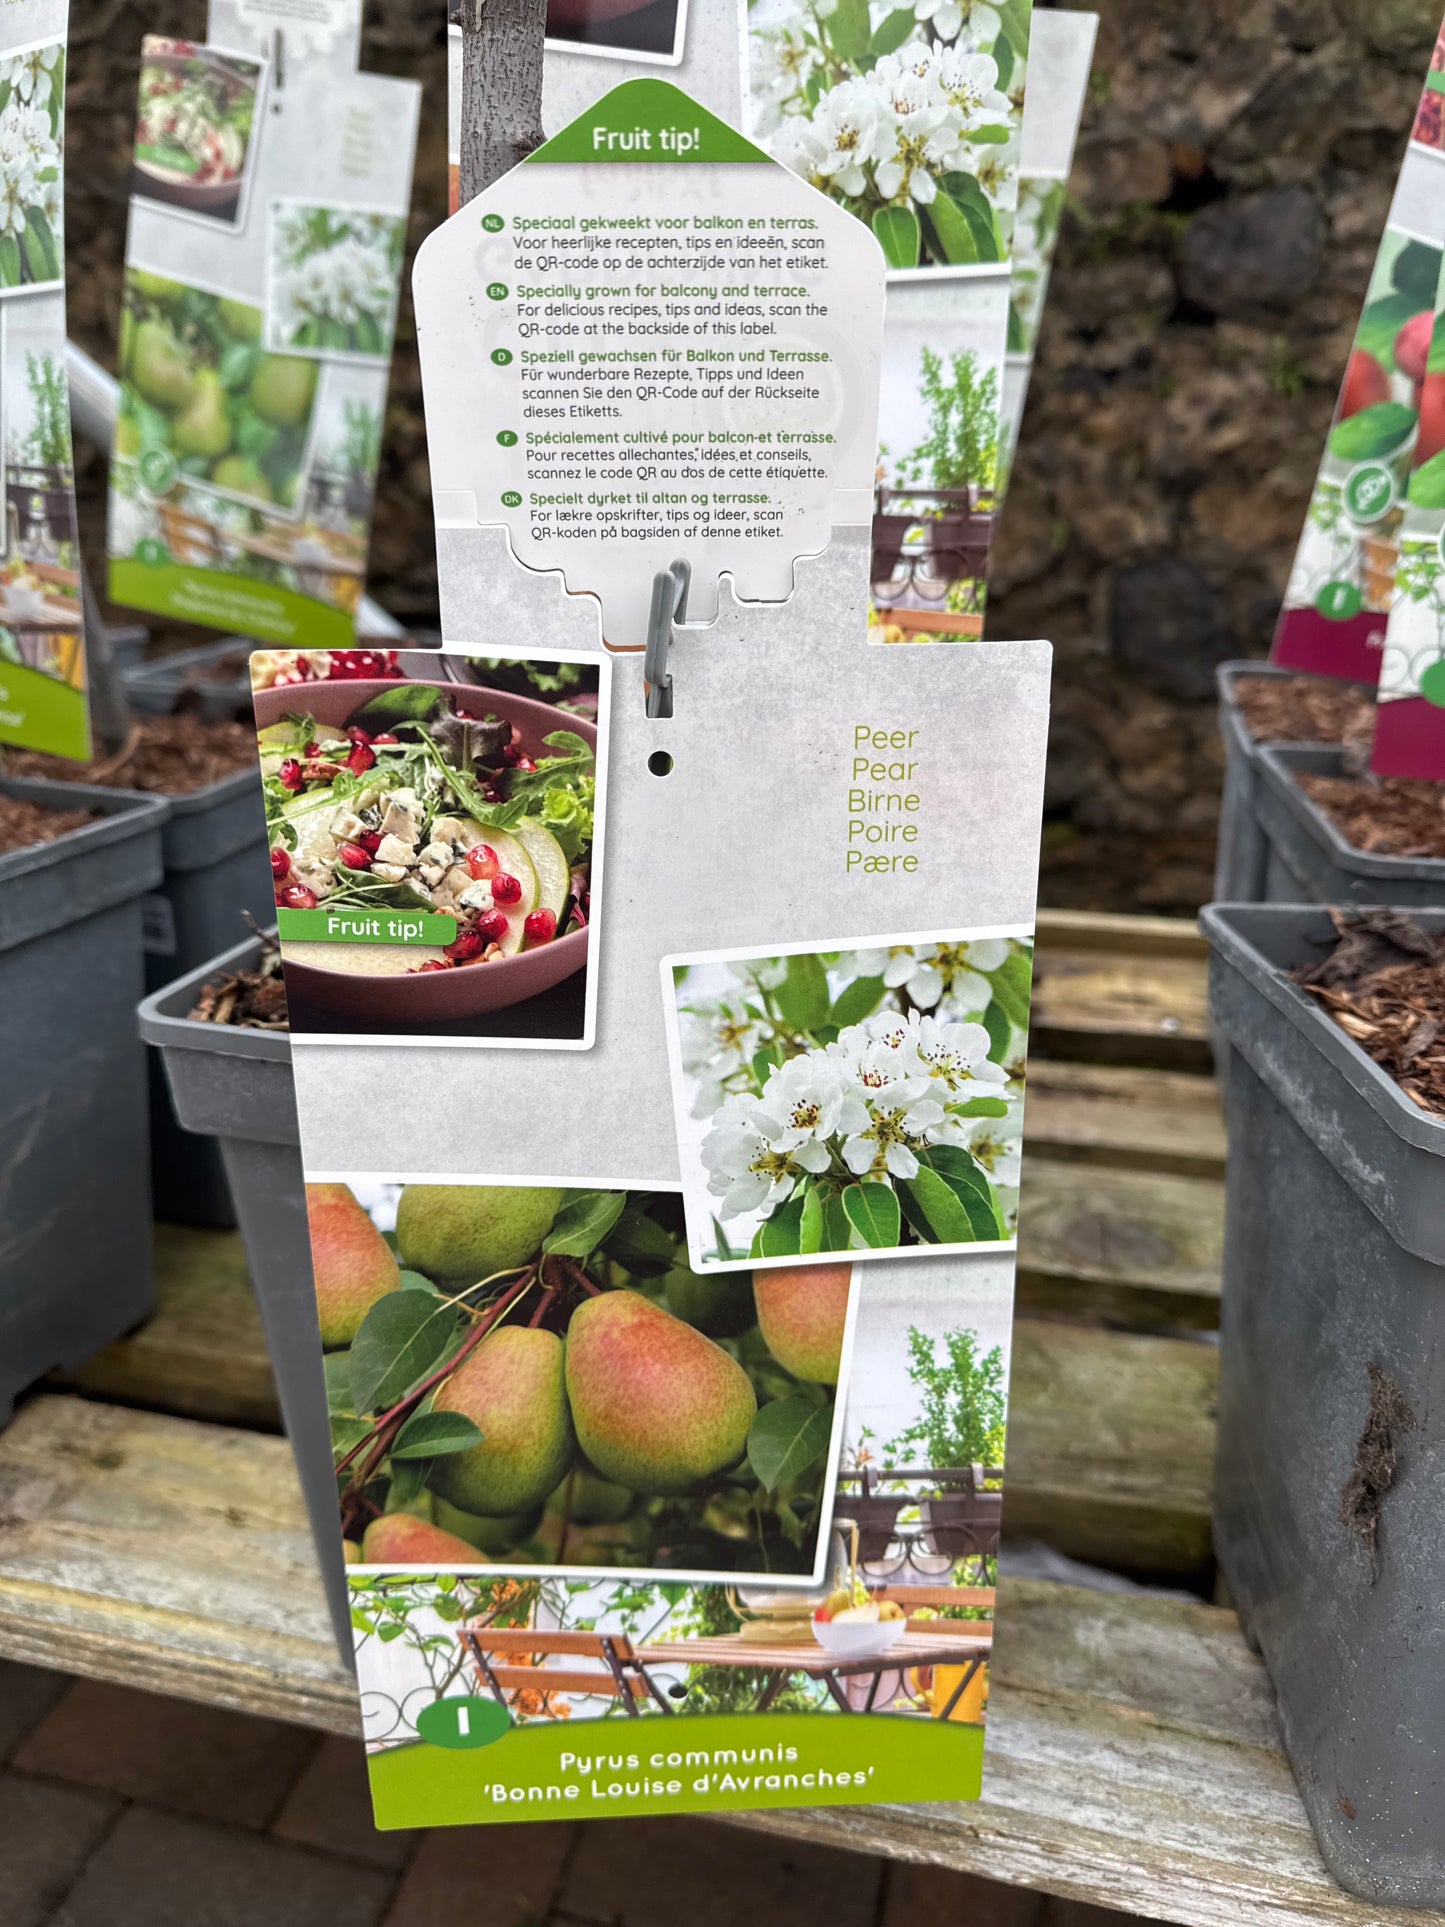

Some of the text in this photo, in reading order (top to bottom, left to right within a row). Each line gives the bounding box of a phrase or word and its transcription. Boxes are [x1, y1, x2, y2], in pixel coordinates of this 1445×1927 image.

[593, 127, 700, 156] Fruit tip!
[485, 216, 503, 229] NL
[512, 216, 818, 232] Speciaal gekweekt voor balkon en terras.
[512, 235, 824, 252] Voor heerlijke recepten, tips en ideeën, scan
[514, 255, 828, 272] de QR-code op de achterzijde van het etiket.
[490, 286, 505, 297] EN
[516, 283, 810, 300] Specially grown for balcony and terrace.
[517, 302, 828, 318] For delicious recipes, tips and ideas, scan the
[518, 321, 776, 338] QR-code at the backside of this label.
[520, 349, 832, 366] Speziell gewachsen für Balkon und Terrasse.
[521, 367, 804, 383] Für wunderbare Rezepte, Tipps und Ideen
[522, 386, 820, 402] scannen Sie den QR-Code auf der Rückseite
[523, 405, 622, 418] dieses Etiketts.
[526, 431, 619, 447] Spécialement
[623, 430, 668, 444] cultivé
[672, 433, 704, 446] pour
[776, 430, 837, 444] terrasse.
[526, 449, 557, 462] Pour
[561, 450, 615, 461] recettes
[739, 449, 752, 460] et
[756, 448, 812, 462] conseils,
[527, 466, 828, 481] scannez le code QR au dos de cette étiquette.
[502, 494, 519, 506] DK
[530, 492, 771, 507] Specielt dyrket til altan og terrasse.
[530, 508, 783, 524] For lækre opskrifter, tips og ideer, scan
[531, 525, 783, 541] QR-koden på bagsiden af denne etiket.
[854, 725, 920, 750] Peer
[853, 757, 919, 782] Pear
[848, 789, 920, 813] Birne
[848, 820, 918, 843] Poire
[846, 850, 919, 874] Pære
[328, 917, 423, 941] Fruit tip!
[560, 1743, 798, 1776] Pyrus communis
[591, 1777, 682, 1799] Louise
